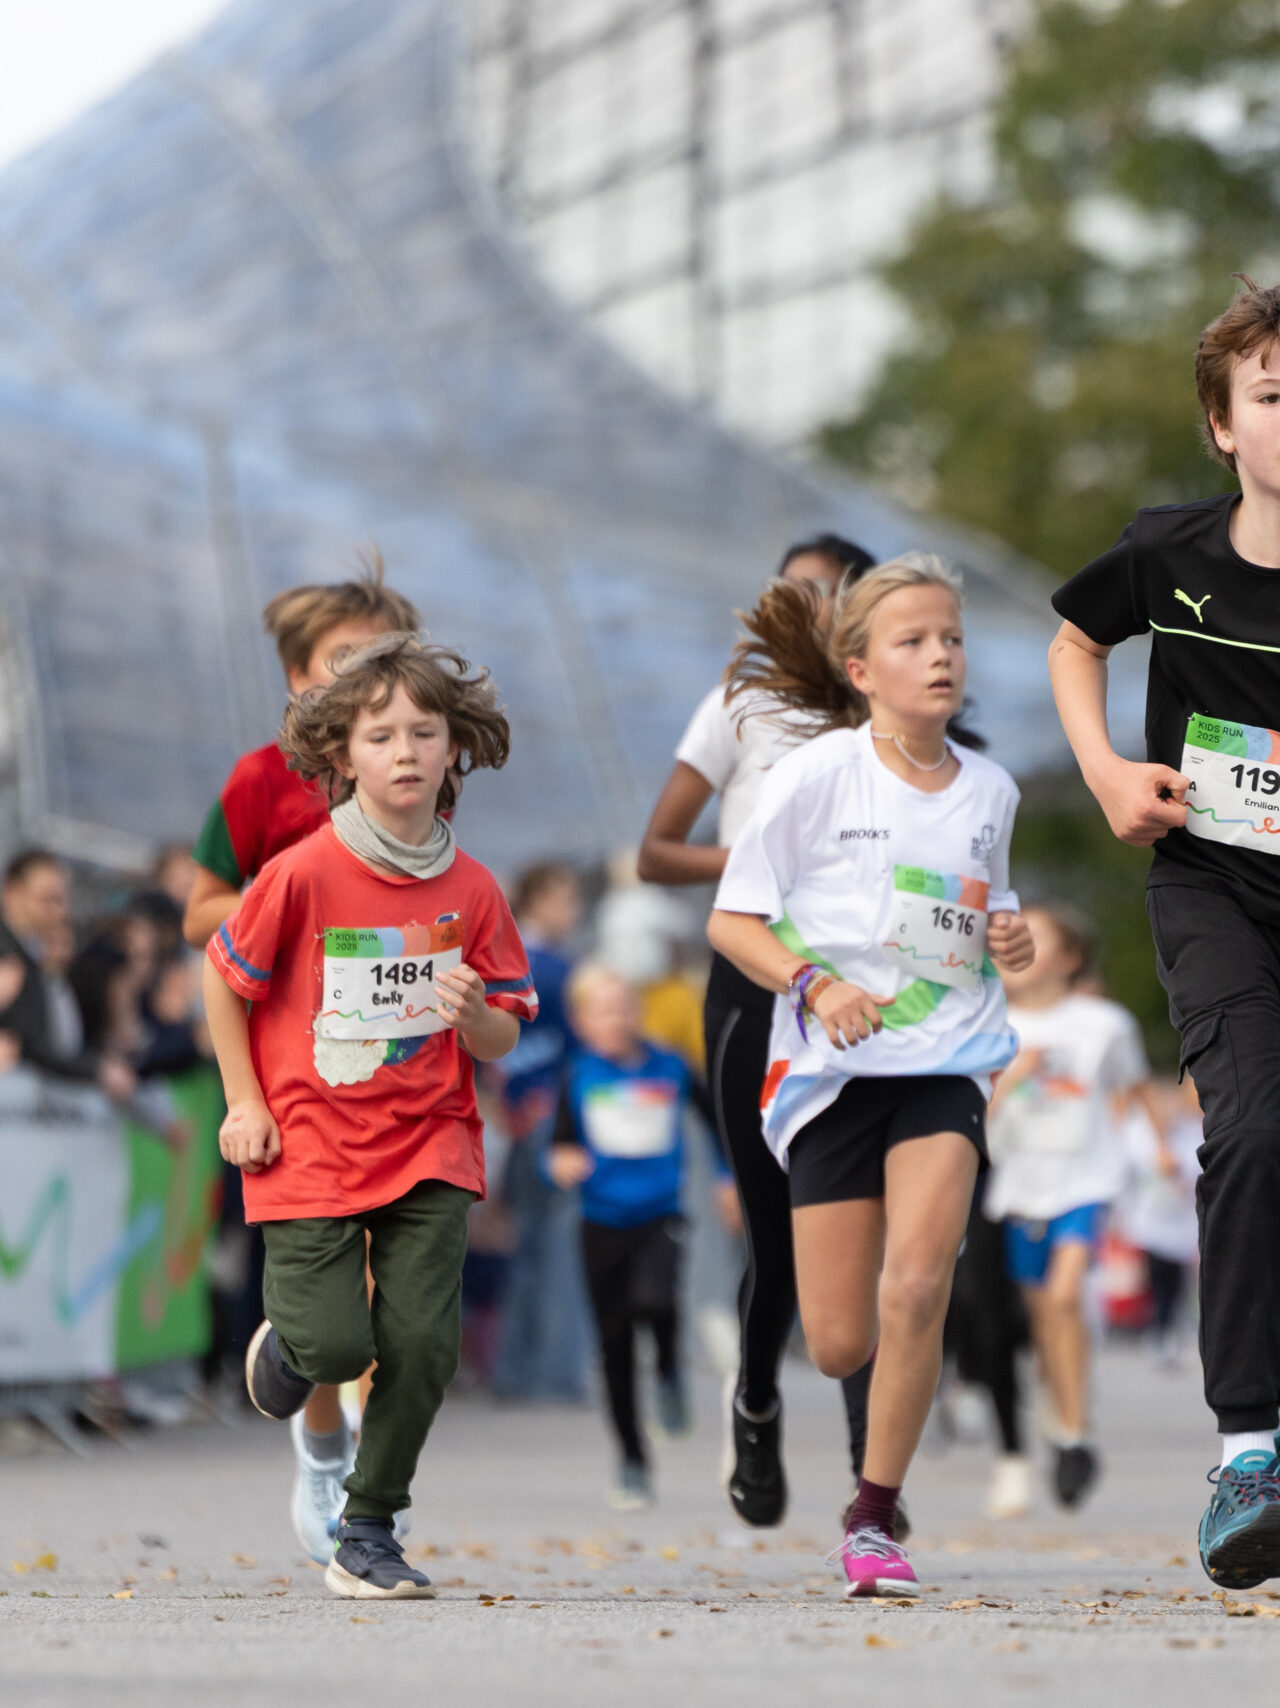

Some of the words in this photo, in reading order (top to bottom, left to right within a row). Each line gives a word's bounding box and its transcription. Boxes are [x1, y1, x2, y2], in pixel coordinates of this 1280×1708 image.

[1198, 721, 1220, 734] KIDS
[1222, 726, 1244, 738] RUN
[1197, 731, 1220, 744] 2025
[1244, 798, 1280, 812] Emilian
[840, 829, 890, 840] BROOKS
[932, 906, 975, 936] 1616
[900, 924, 907, 933] C
[335, 934, 357, 942] KIDS
[358, 934, 378, 942] RUN
[335, 943, 358, 951] 2025
[370, 959, 434, 986] 1484
[333, 989, 343, 1000] C
